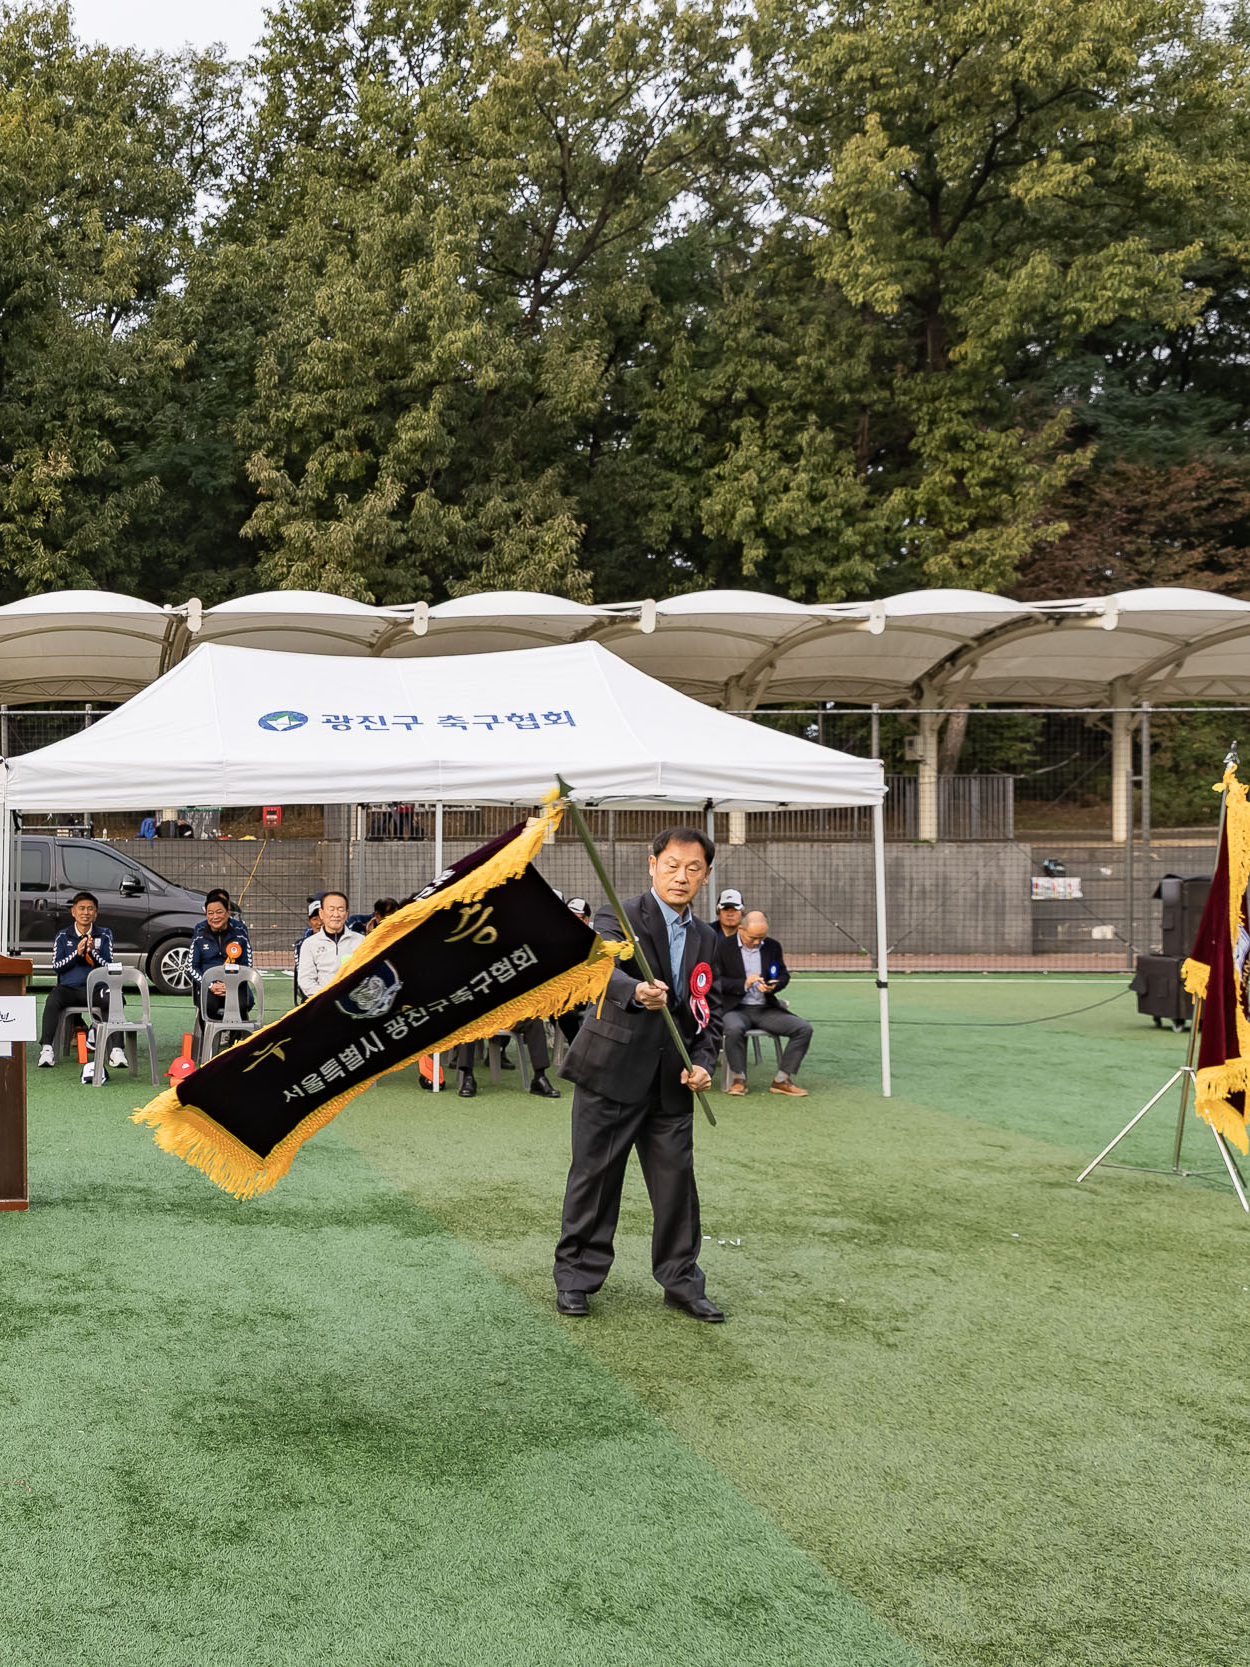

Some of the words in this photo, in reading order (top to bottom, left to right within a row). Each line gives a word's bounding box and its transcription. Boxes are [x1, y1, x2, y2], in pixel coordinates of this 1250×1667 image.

[321, 713, 424, 731] 광진구
[437, 710, 577, 731] 축구협회
[282, 1029, 386, 1103] 서울특별시
[382, 943, 539, 1041] 광진구축구협회
